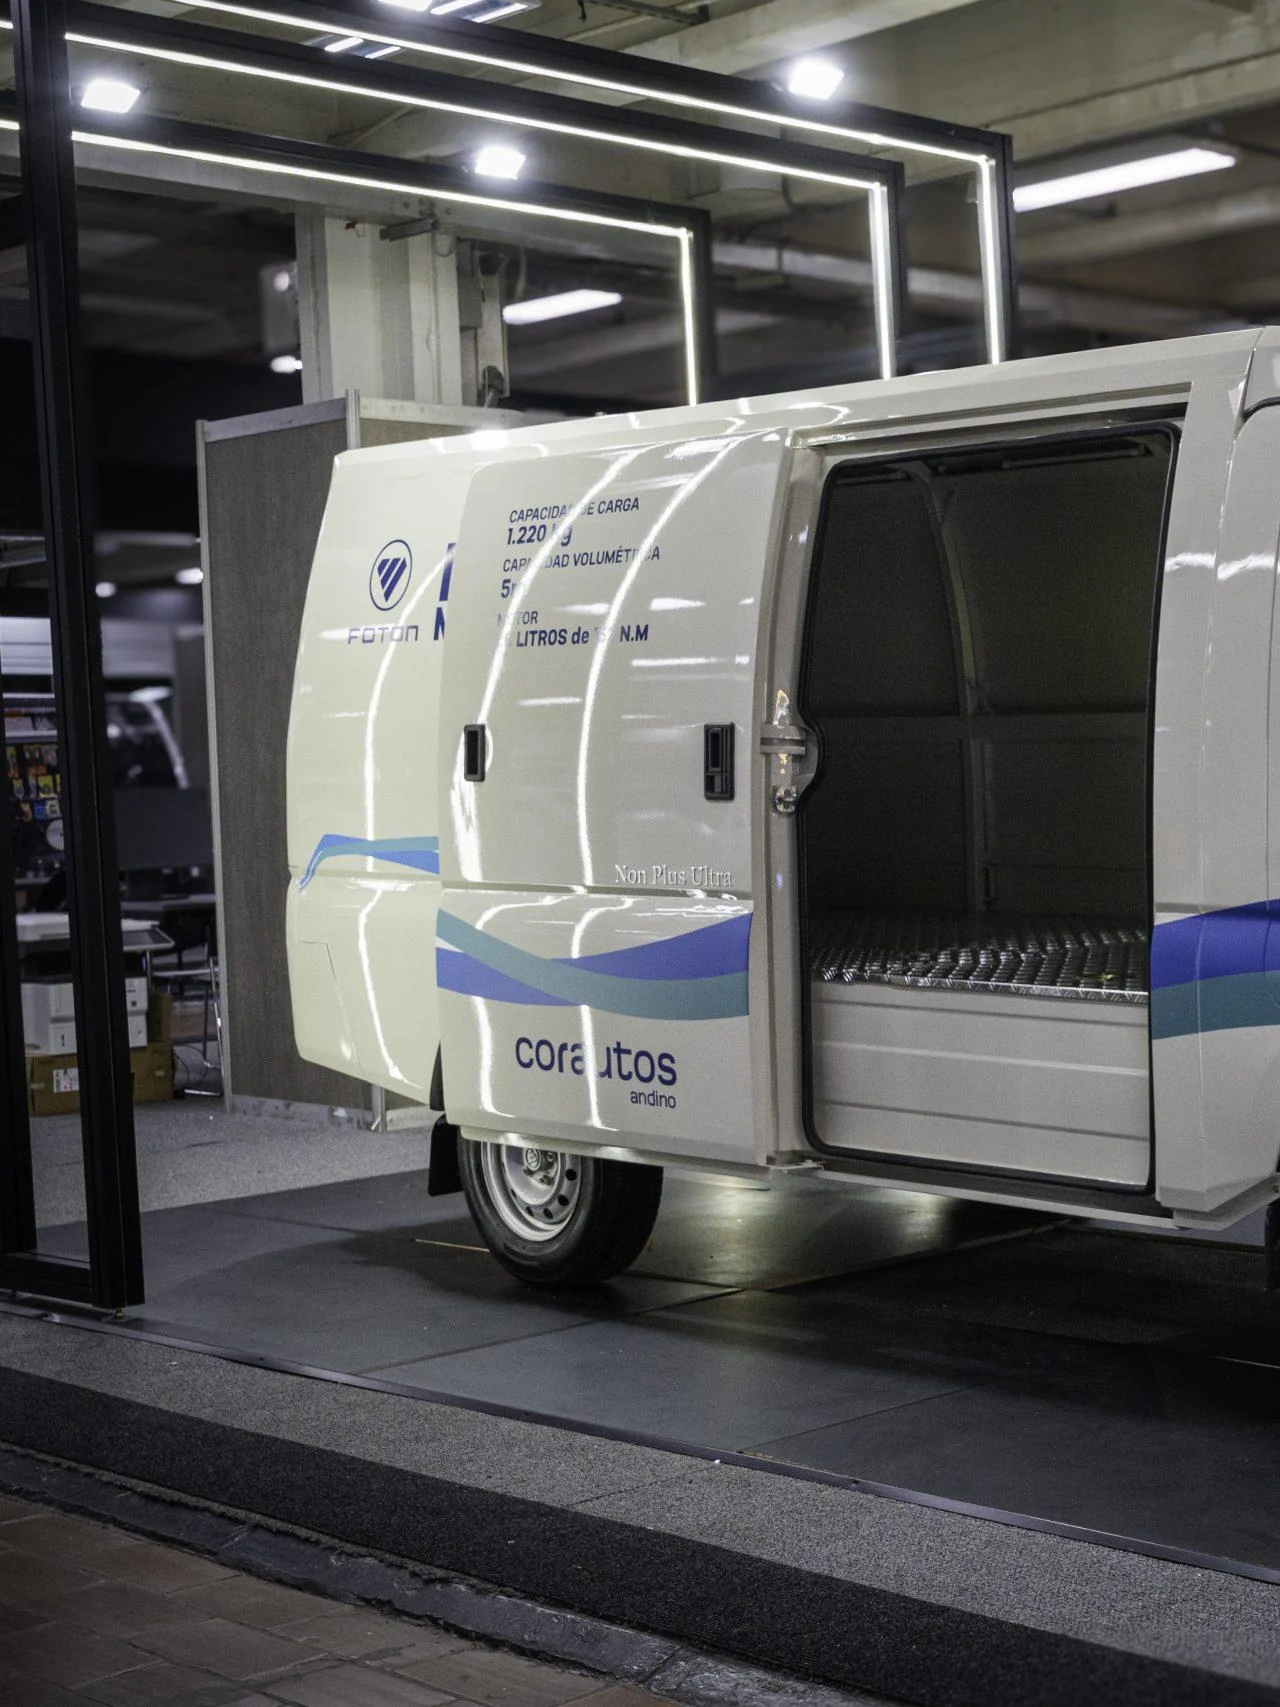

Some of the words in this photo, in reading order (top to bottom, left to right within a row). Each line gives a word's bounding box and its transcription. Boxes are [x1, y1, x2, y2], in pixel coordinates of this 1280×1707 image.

[597, 497, 640, 514] CARGA
[506, 524, 547, 545] 1.220
[348, 625, 419, 645] FOTON
[516, 628, 568, 648] LITROS
[571, 626, 590, 644] de
[620, 624, 649, 642] N.M
[614, 864, 646, 884] Non
[652, 865, 686, 886] Plus
[691, 866, 733, 887] Ultra
[630, 1089, 677, 1109] andino
